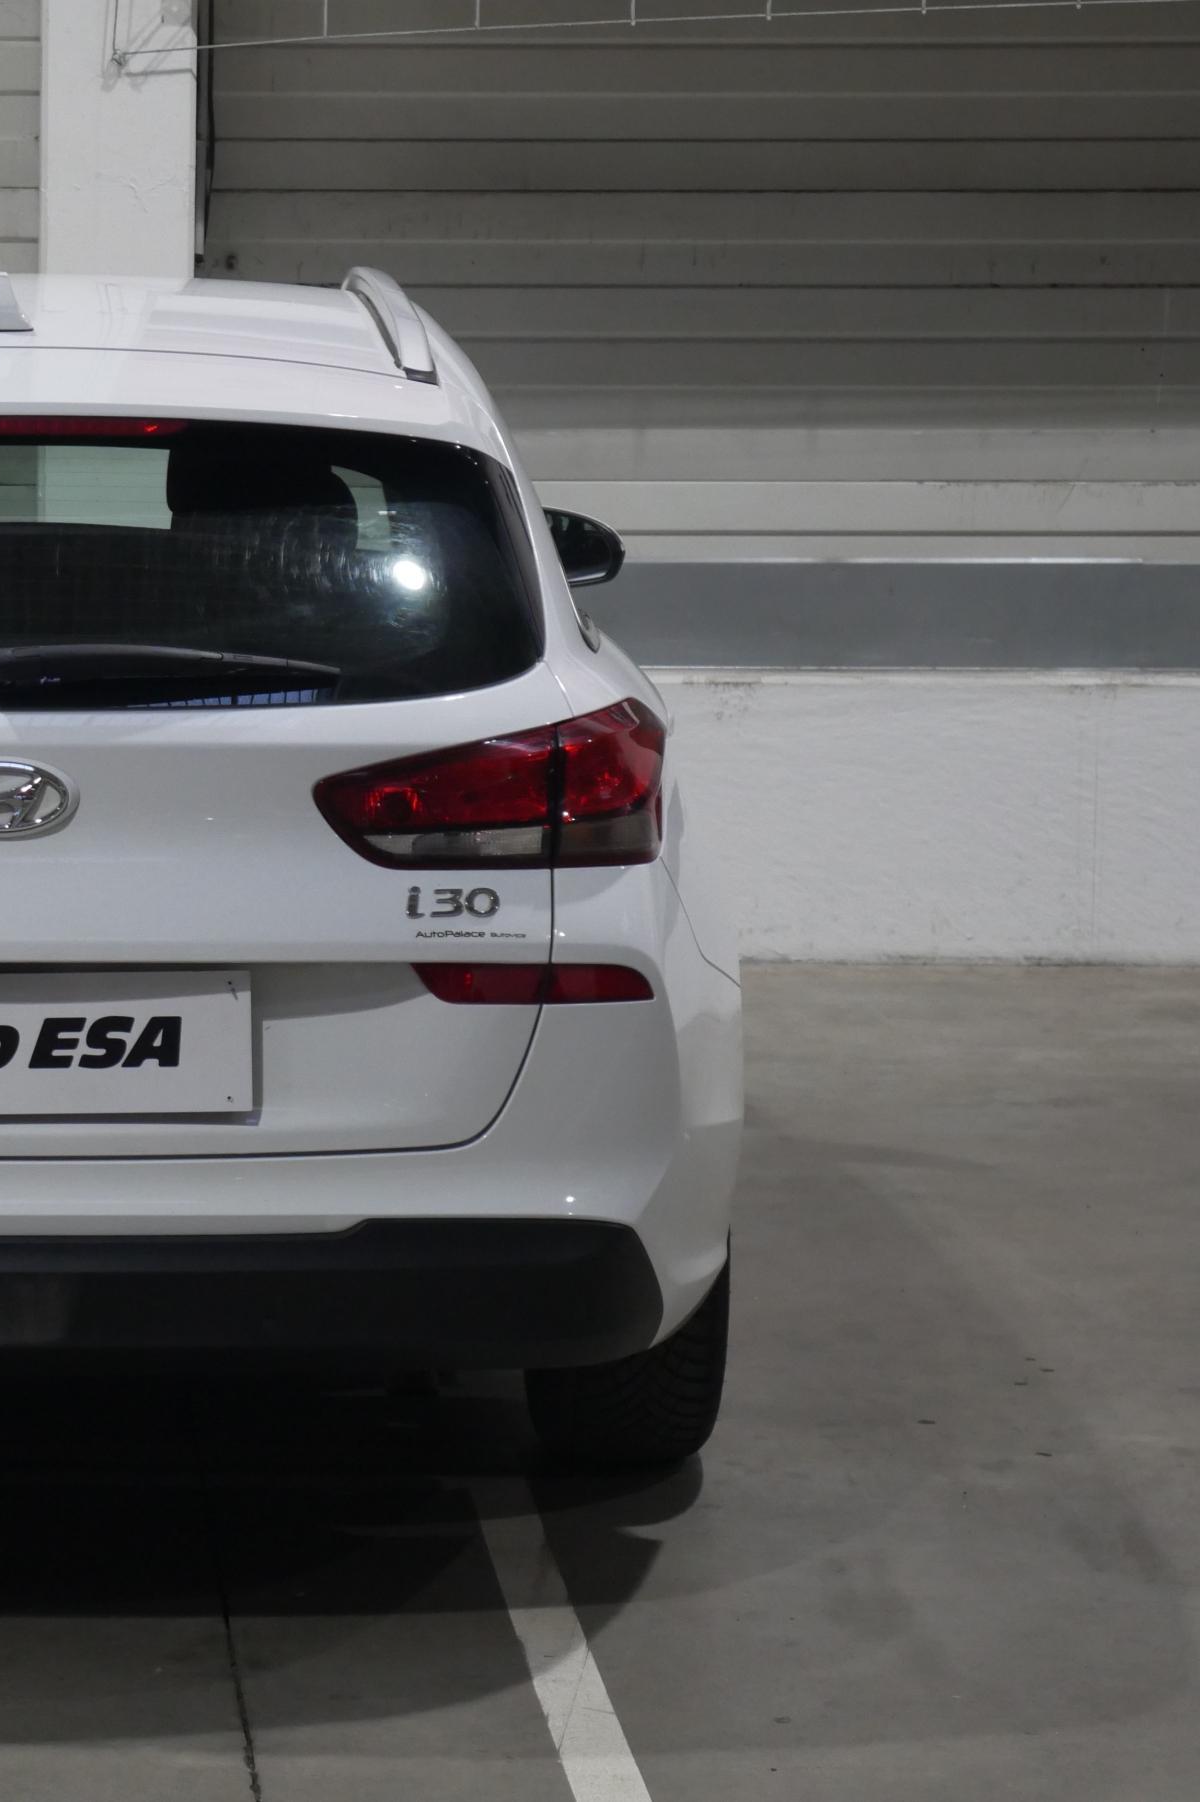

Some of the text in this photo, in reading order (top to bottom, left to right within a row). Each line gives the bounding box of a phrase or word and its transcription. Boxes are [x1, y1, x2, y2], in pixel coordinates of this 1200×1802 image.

[405, 885, 500, 919] i30
[415, 930, 486, 938] AutoPalace
[28, 1015, 182, 1069] ESA
